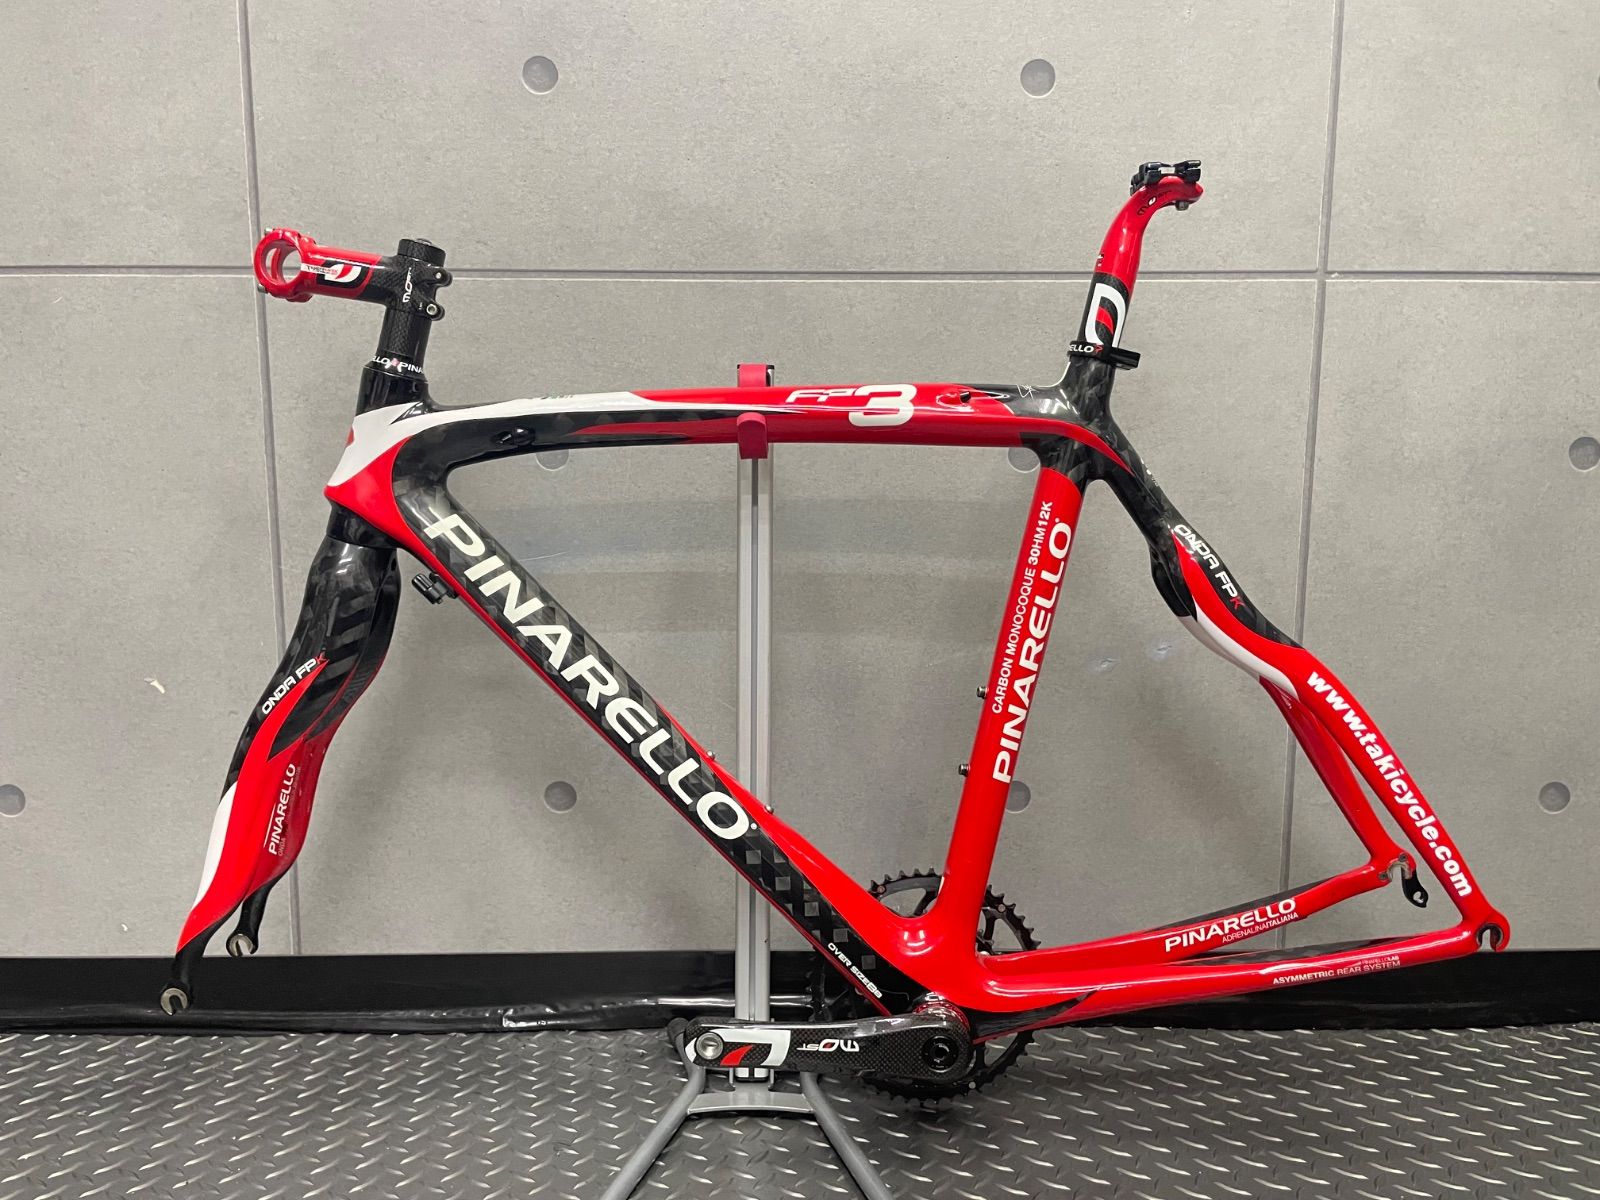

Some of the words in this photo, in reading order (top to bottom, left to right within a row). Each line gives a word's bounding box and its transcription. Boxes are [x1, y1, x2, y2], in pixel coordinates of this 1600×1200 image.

[1174, 524, 1220, 570] ONDA
[992, 657, 1014, 714] CARBON
[1005, 567, 1036, 656] MONOCOQUE
[1028, 501, 1052, 565] 30HM12K
[424, 513, 750, 840] PINARELLO
[992, 523, 1072, 784] PINARELLO
[262, 675, 297, 714] ONDA
[268, 763, 296, 855] PINARELLO
[1306, 671, 1473, 897] www.takicycle.com
[827, 942, 852, 967] OVER
[1164, 898, 1297, 953] PINARELLO
[1272, 970, 1335, 985] ASYMMETRIC
[1336, 967, 1361, 977] REAR
[1363, 960, 1400, 972] SYSTEM
